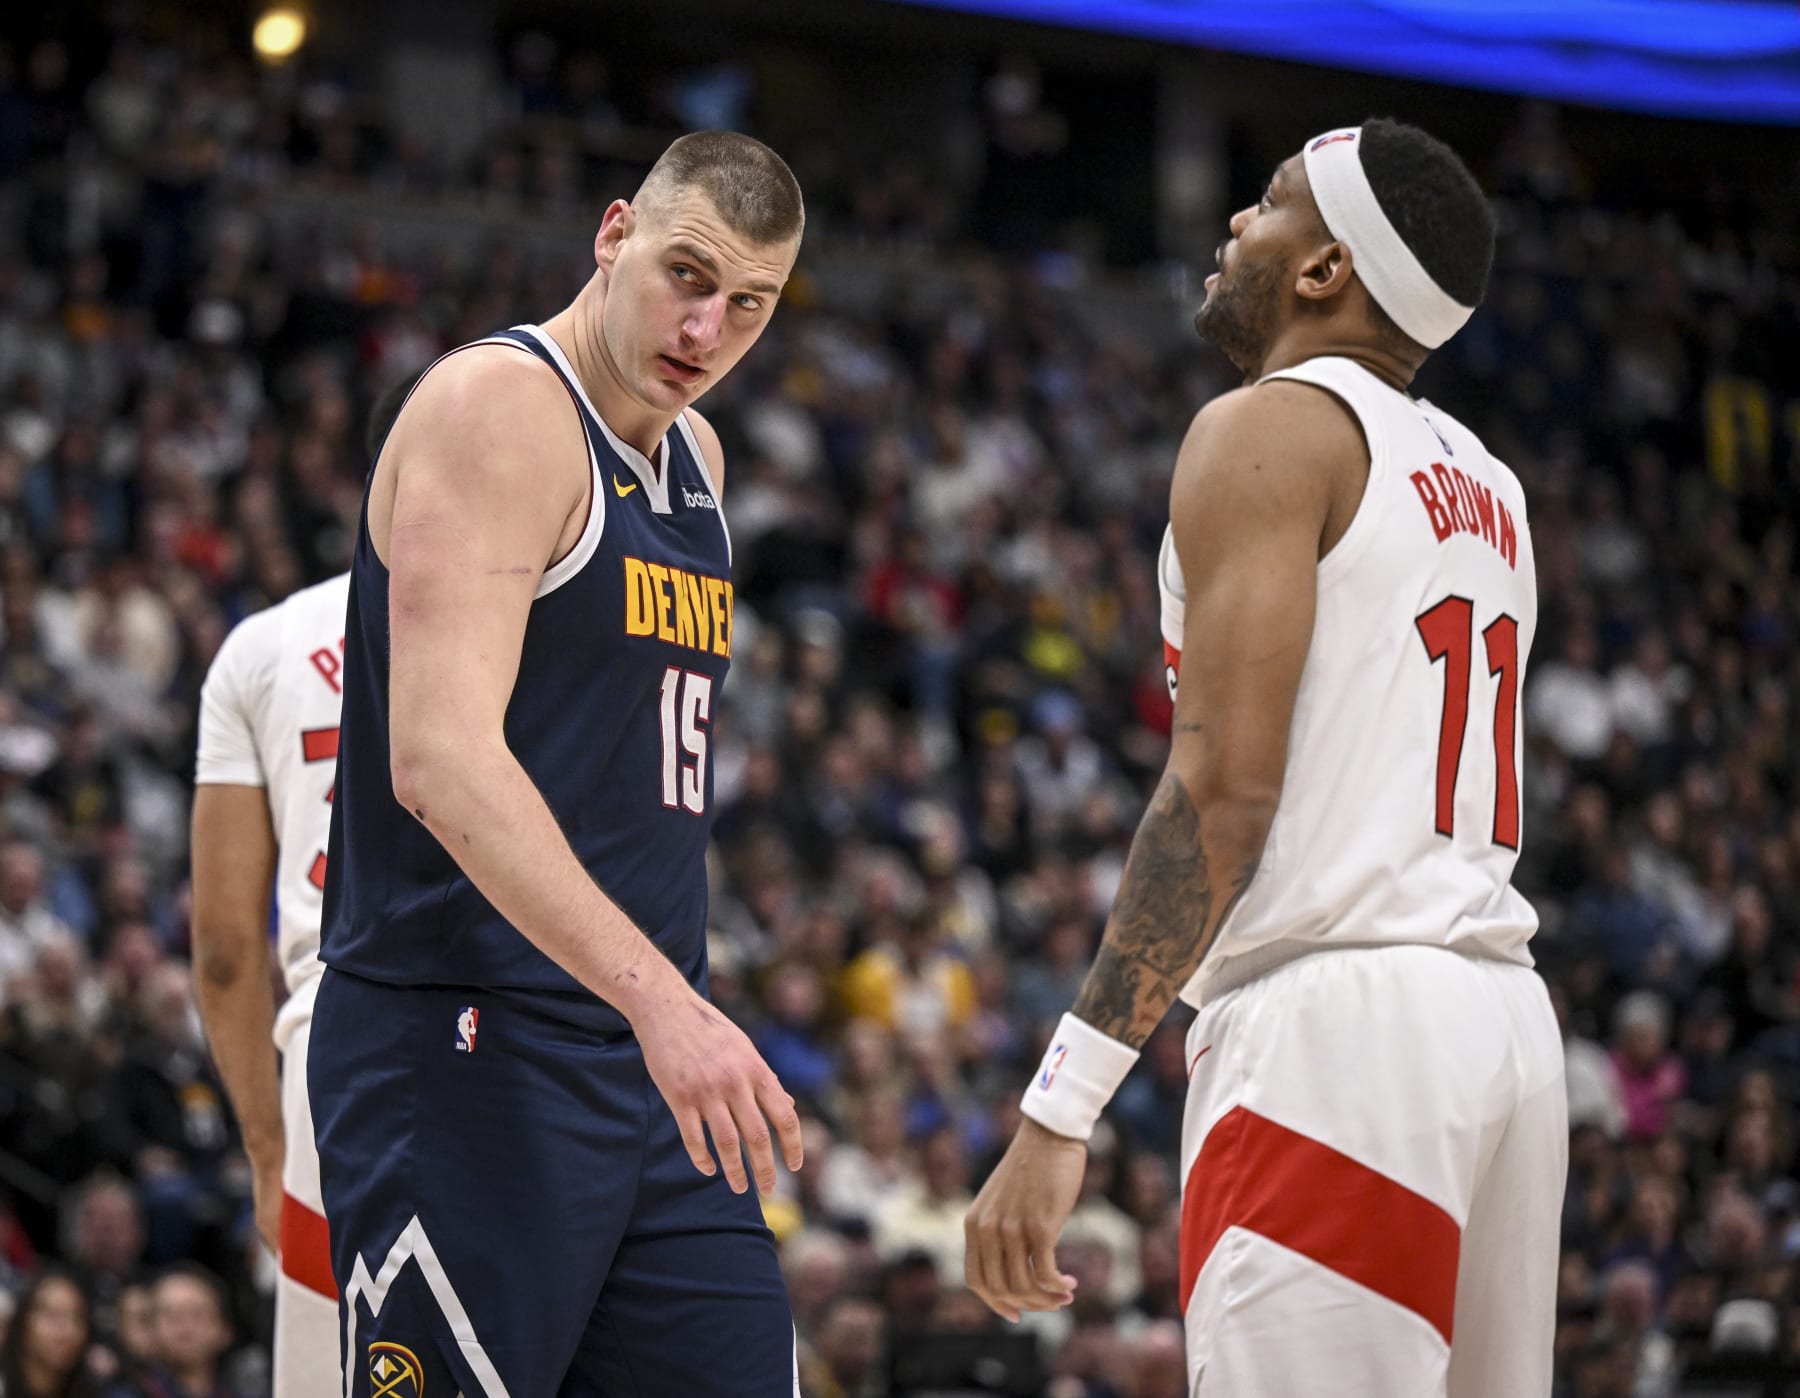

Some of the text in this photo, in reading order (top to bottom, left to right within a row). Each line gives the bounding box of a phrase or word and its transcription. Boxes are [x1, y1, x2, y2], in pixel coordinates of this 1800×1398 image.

[1410, 462, 1517, 571] BROWN
[659, 664, 713, 816] 15
[1414, 594, 1519, 853] 11
